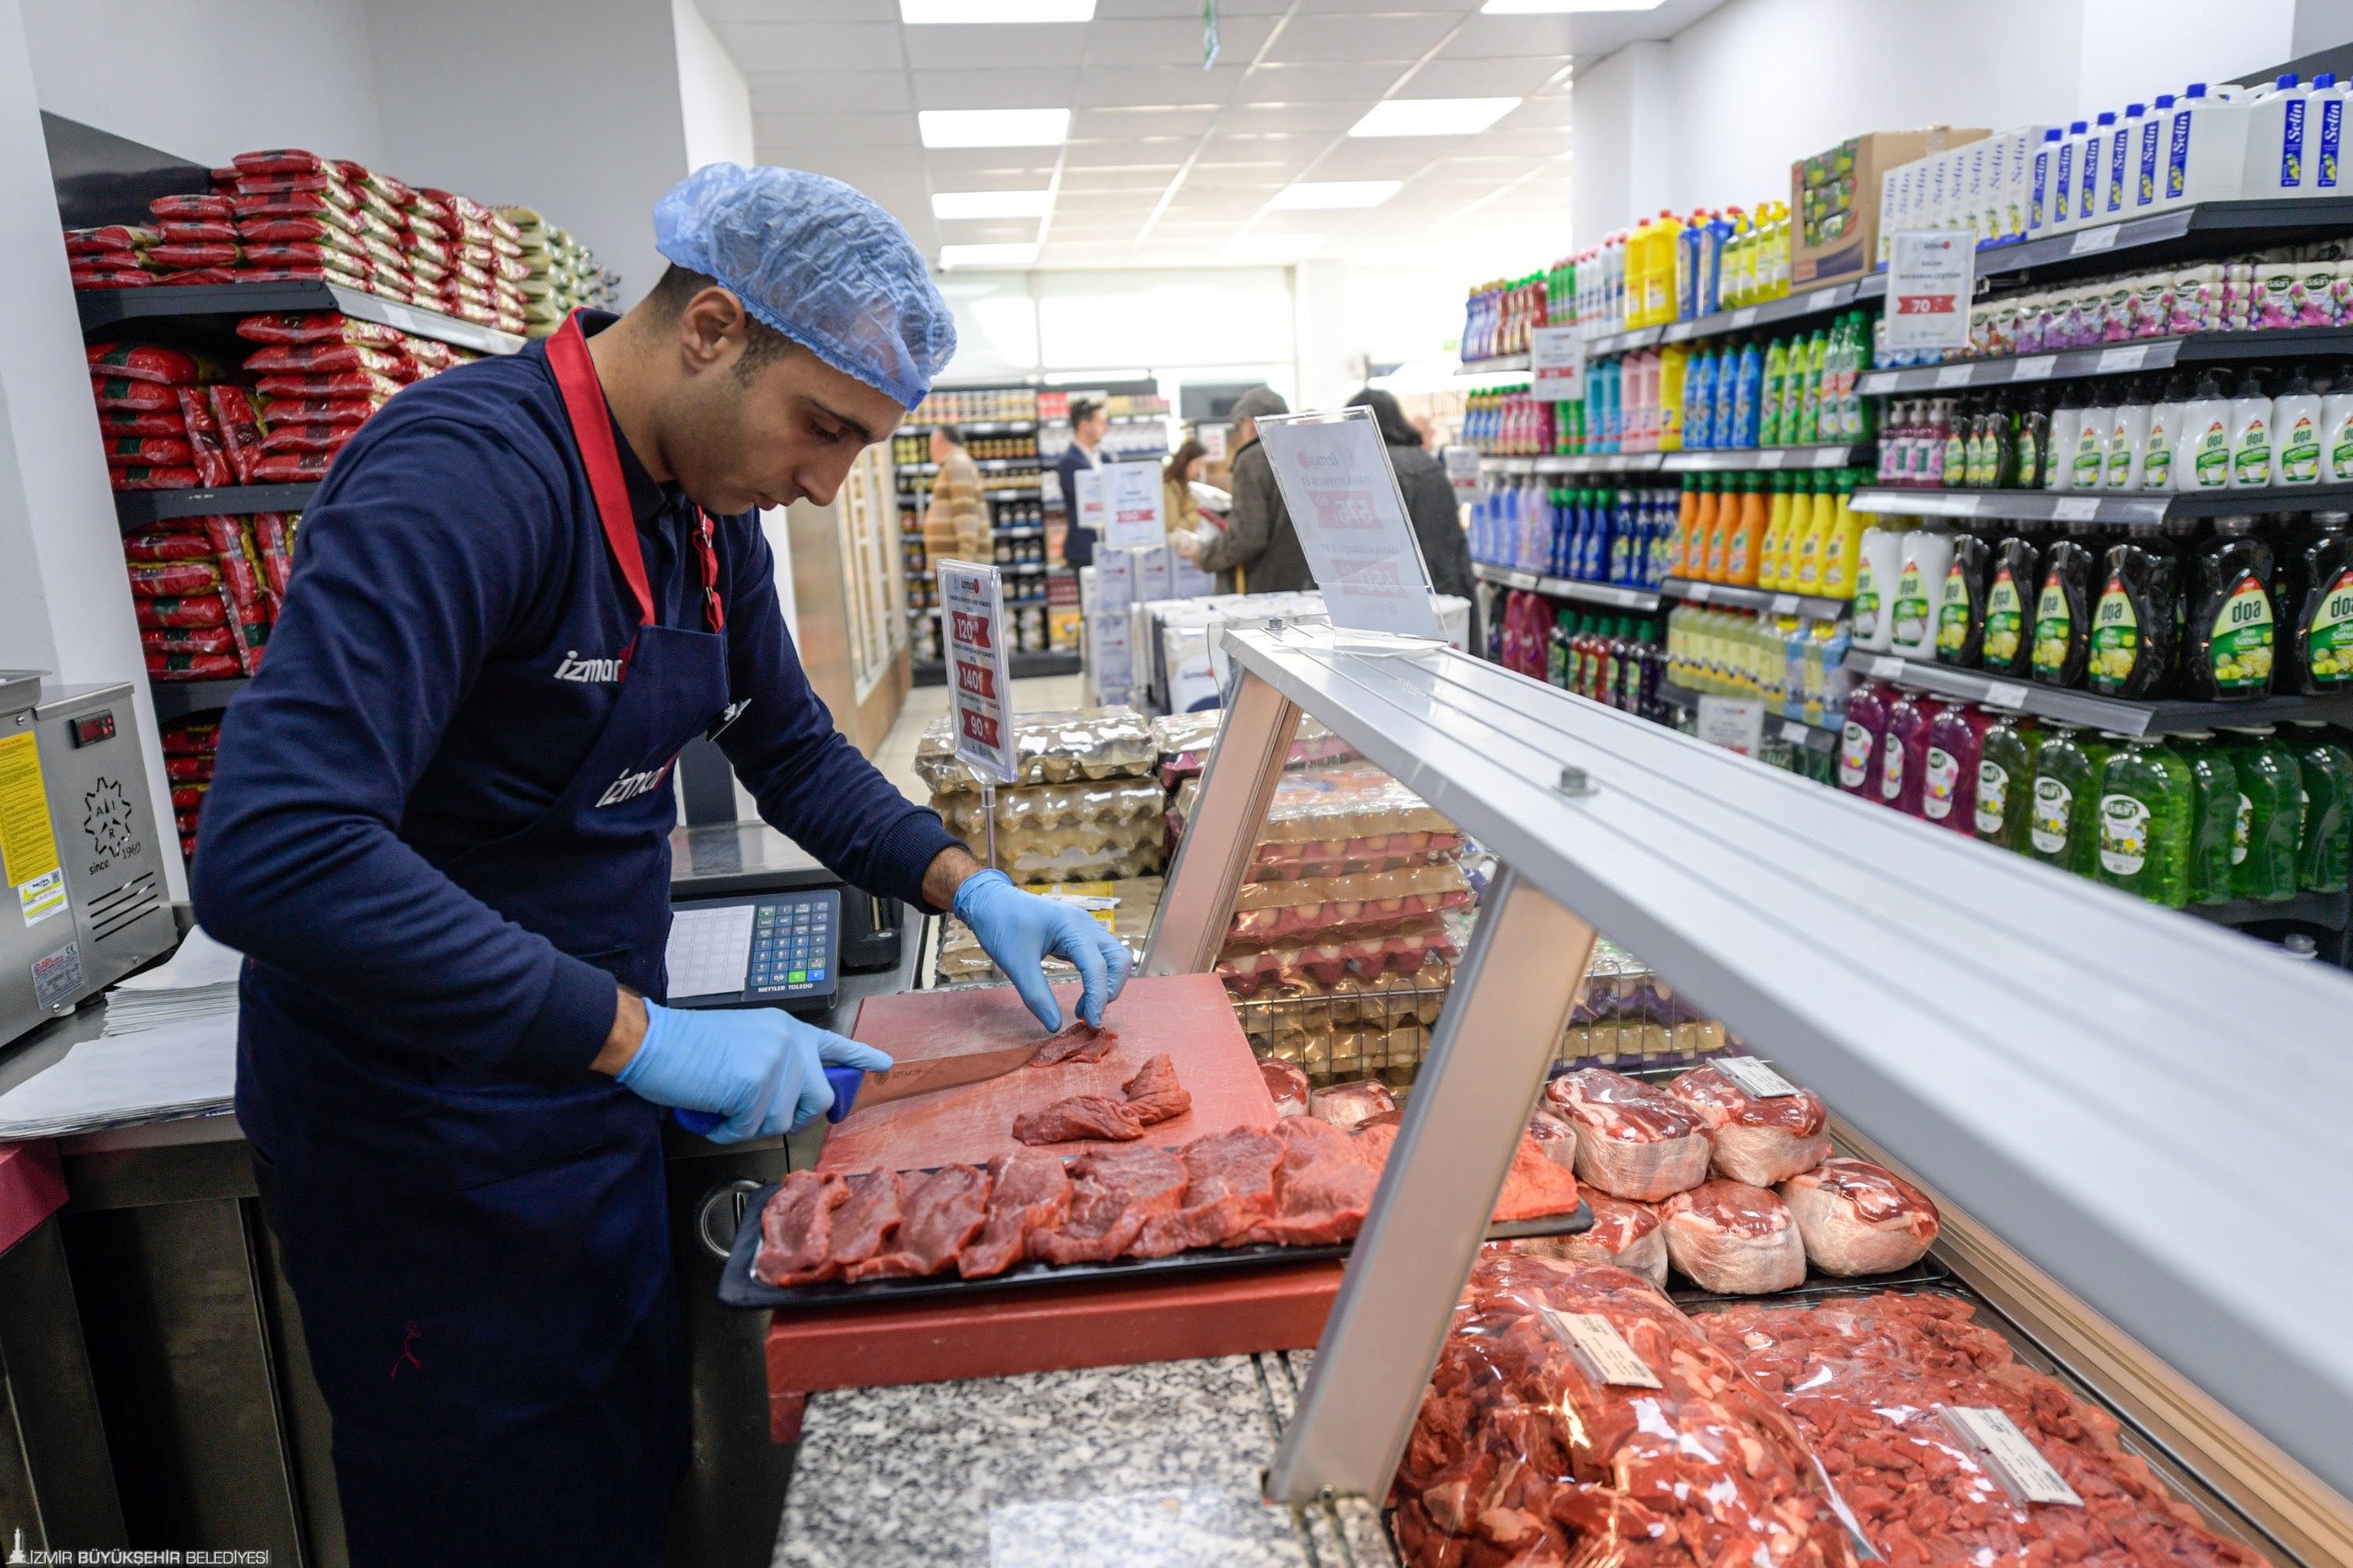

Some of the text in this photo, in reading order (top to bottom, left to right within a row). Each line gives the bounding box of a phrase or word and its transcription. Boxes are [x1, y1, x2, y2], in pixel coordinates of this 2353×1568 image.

[2174, 114, 2188, 153] Selin
[2288, 104, 2302, 142] Selin
[2325, 104, 2340, 143] Selin
[2143, 124, 2157, 162] Selin
[2102, 602, 2122, 620] doa
[2232, 600, 2261, 623] doa
[957, 618, 973, 640] 120
[961, 667, 979, 689] 140
[971, 715, 983, 737] 90
[89, 859, 109, 875] since
[788, 983, 813, 991] TOLEDO
